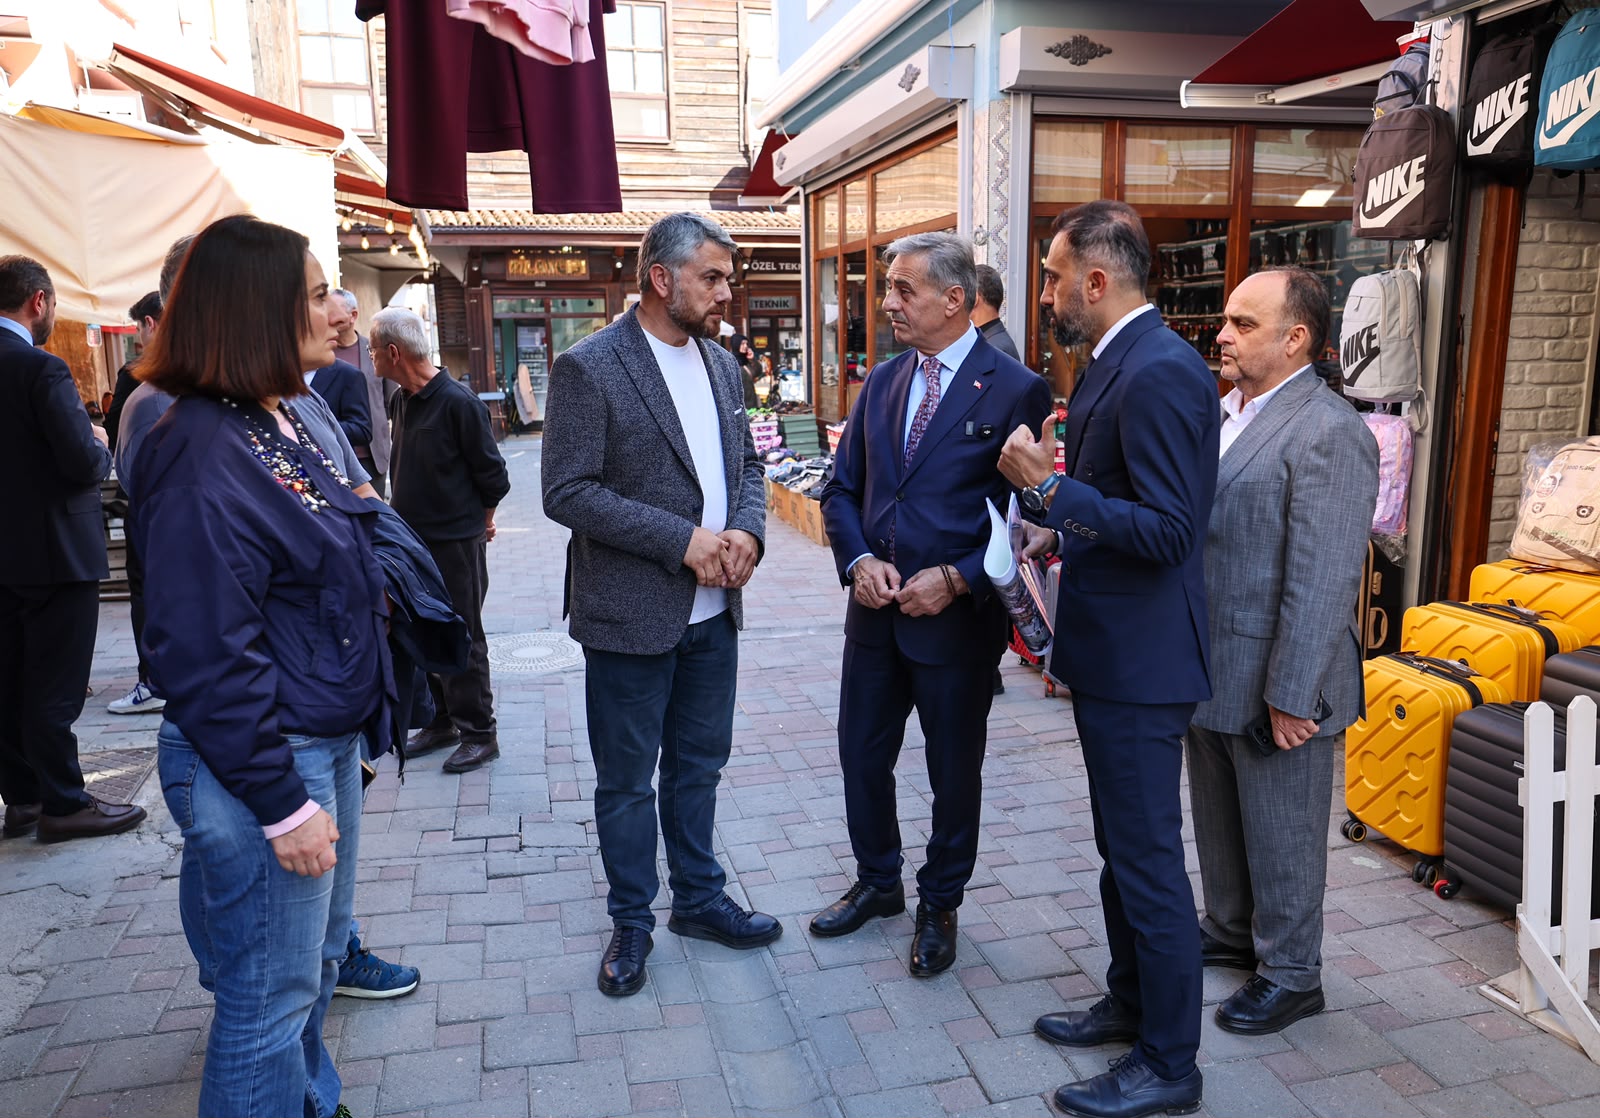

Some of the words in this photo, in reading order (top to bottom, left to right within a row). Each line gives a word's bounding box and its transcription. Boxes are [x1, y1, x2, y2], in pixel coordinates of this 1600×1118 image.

[1472, 72, 1531, 139] NIKE
[1365, 154, 1426, 212] NIKE
[751, 259, 777, 271] ÖZEL
[753, 298, 790, 309] TEKNİK
[1342, 322, 1380, 371] NIKE
